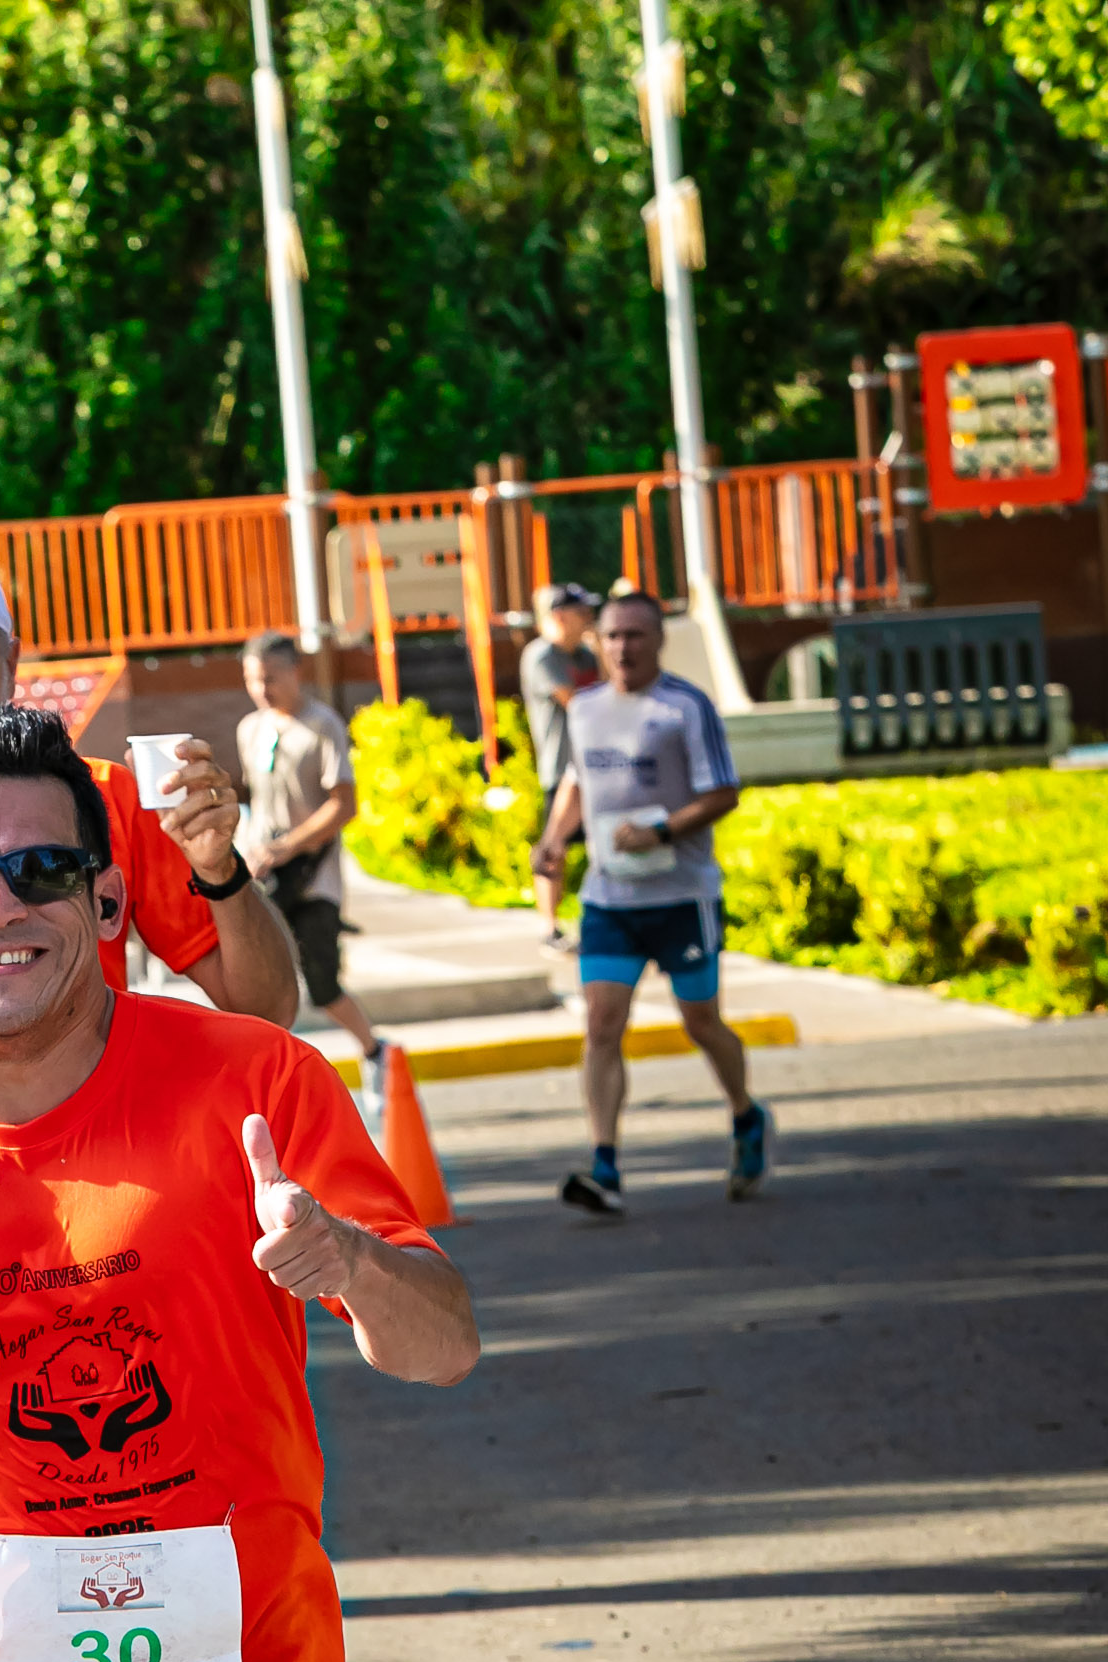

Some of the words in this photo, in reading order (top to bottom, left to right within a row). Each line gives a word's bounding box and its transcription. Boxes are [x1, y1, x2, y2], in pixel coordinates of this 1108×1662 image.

[21, 1249, 140, 1293] ANIVERSARIO
[52, 1304, 95, 1331] San
[104, 1306, 164, 1344] Roque
[35, 1461, 109, 1484] Desde
[118, 1432, 160, 1478] 1975
[93, 1486, 142, 1505] Creamos
[142, 1468, 196, 1495] Esperanza
[104, 1552, 118, 1563] San
[118, 1551, 142, 1561] Roque
